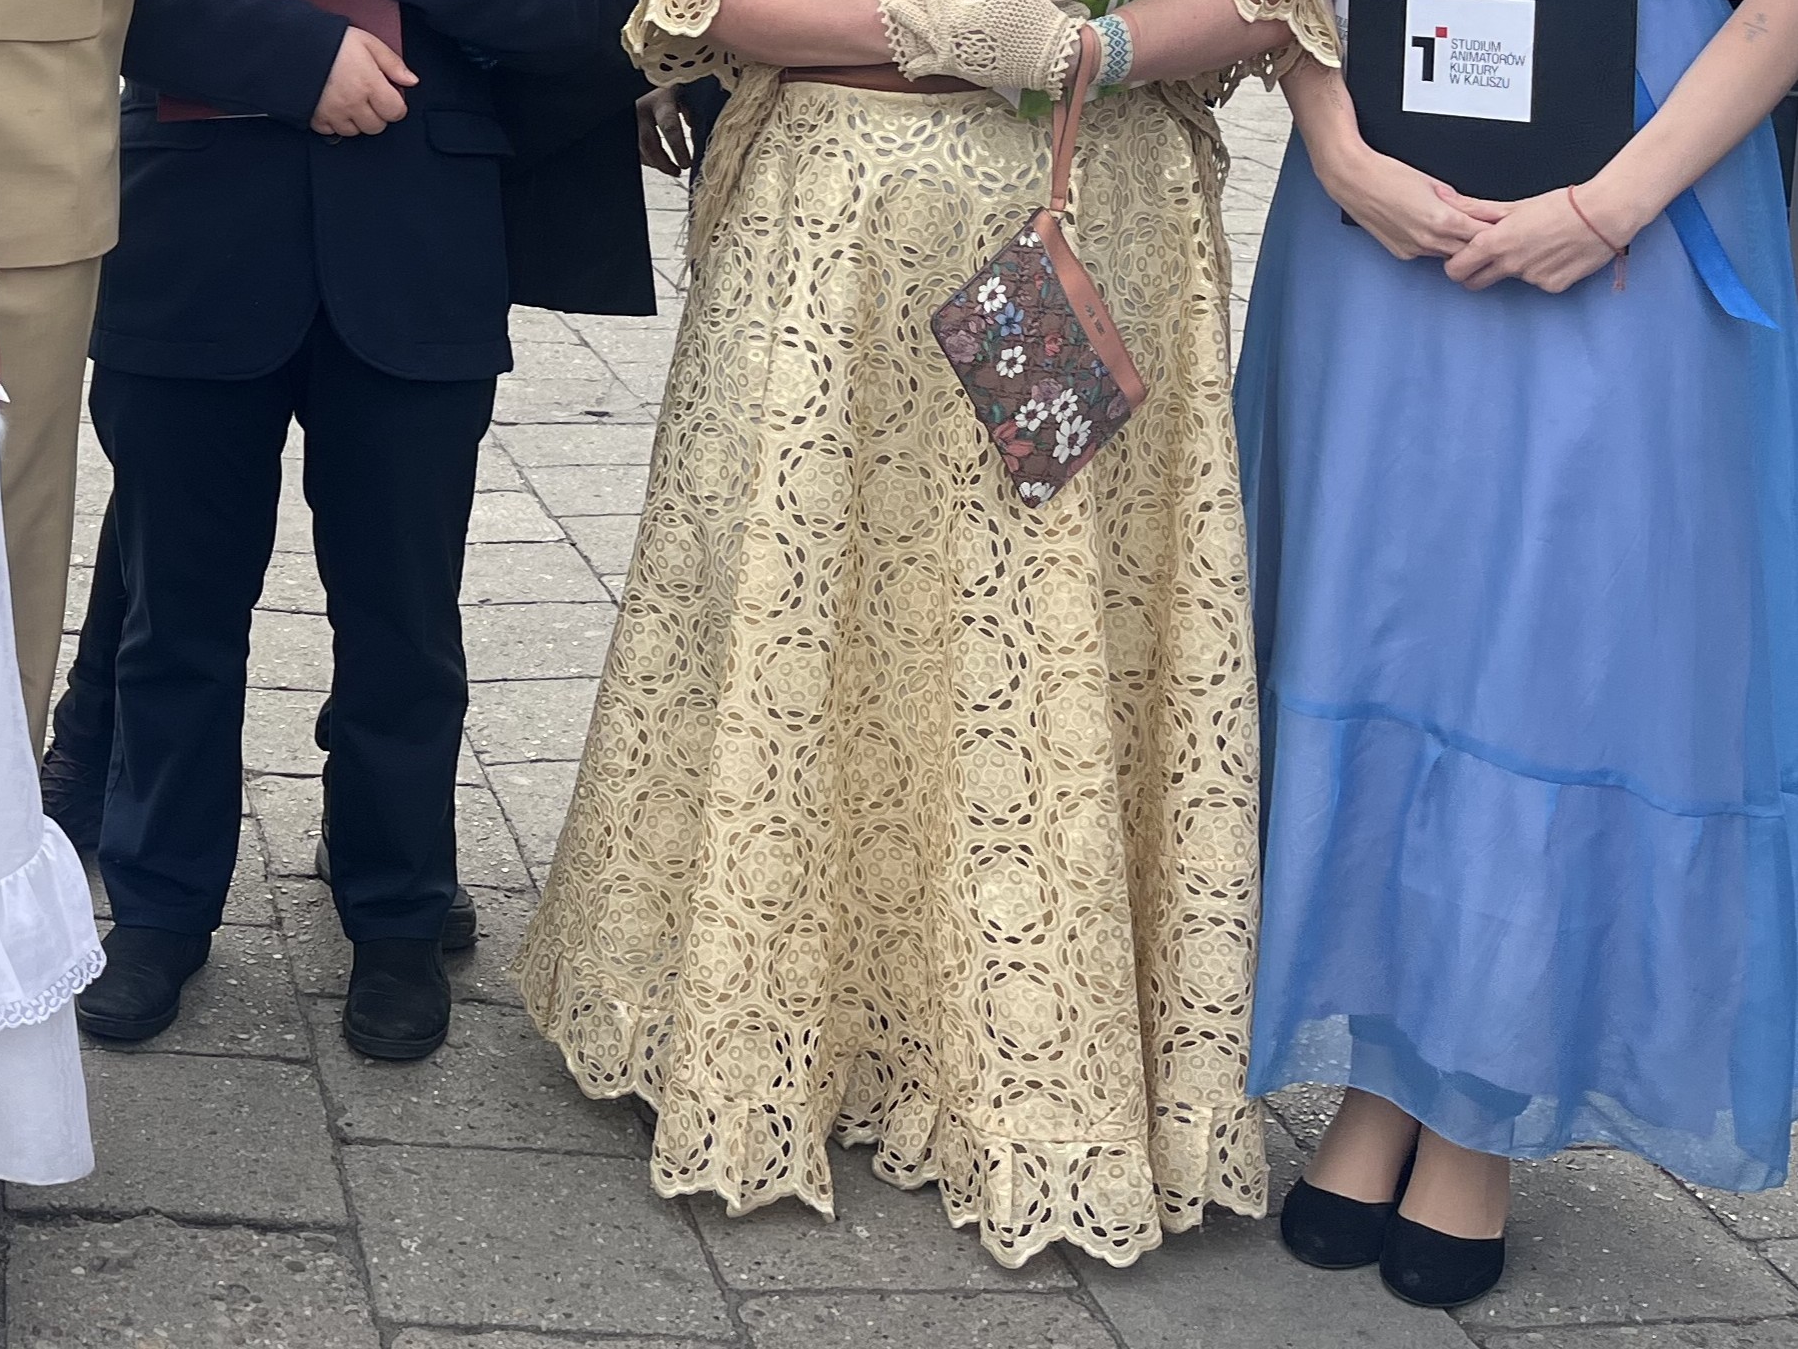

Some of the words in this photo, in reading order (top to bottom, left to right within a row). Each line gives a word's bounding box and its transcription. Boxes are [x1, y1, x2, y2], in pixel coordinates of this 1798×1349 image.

[1451, 38, 1502, 52] STUDIUM
[1449, 50, 1526, 67] ANIMATORÓW
[1449, 62, 1499, 76] KULTURY
[1449, 73, 1460, 85] W
[1464, 74, 1510, 89] KALISZU
